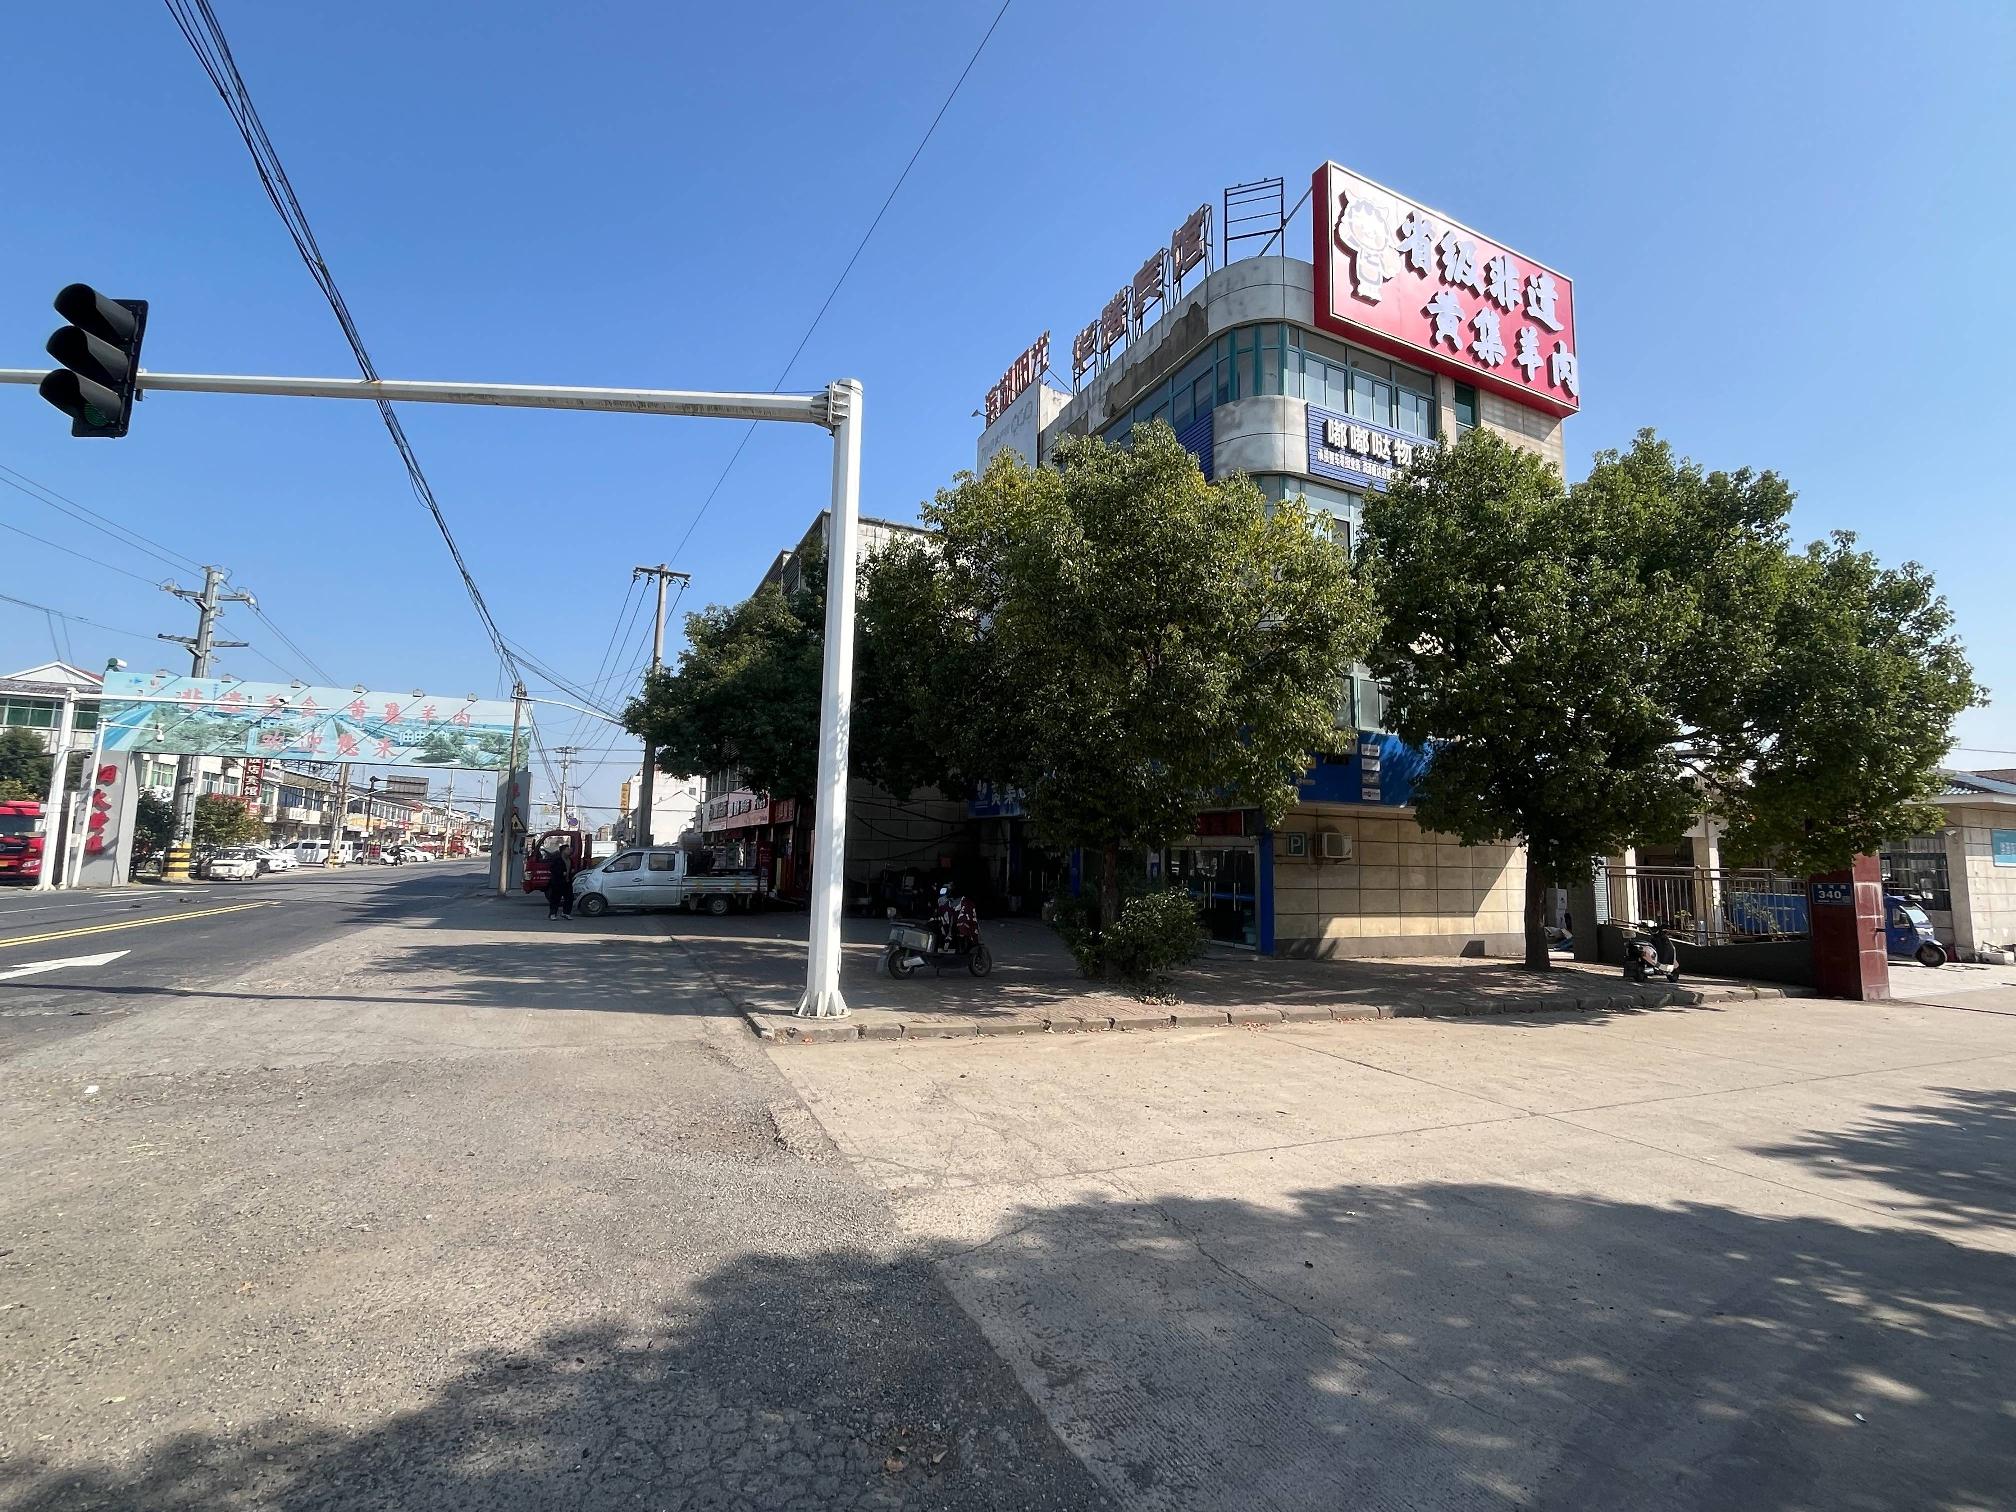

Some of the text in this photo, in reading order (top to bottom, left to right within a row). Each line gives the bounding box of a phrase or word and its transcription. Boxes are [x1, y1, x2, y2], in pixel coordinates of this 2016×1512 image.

[1394, 209, 1565, 332] 省级非遗
[1424, 289, 1578, 397] 黄集羊肉
[1818, 890, 1842, 899] 340
